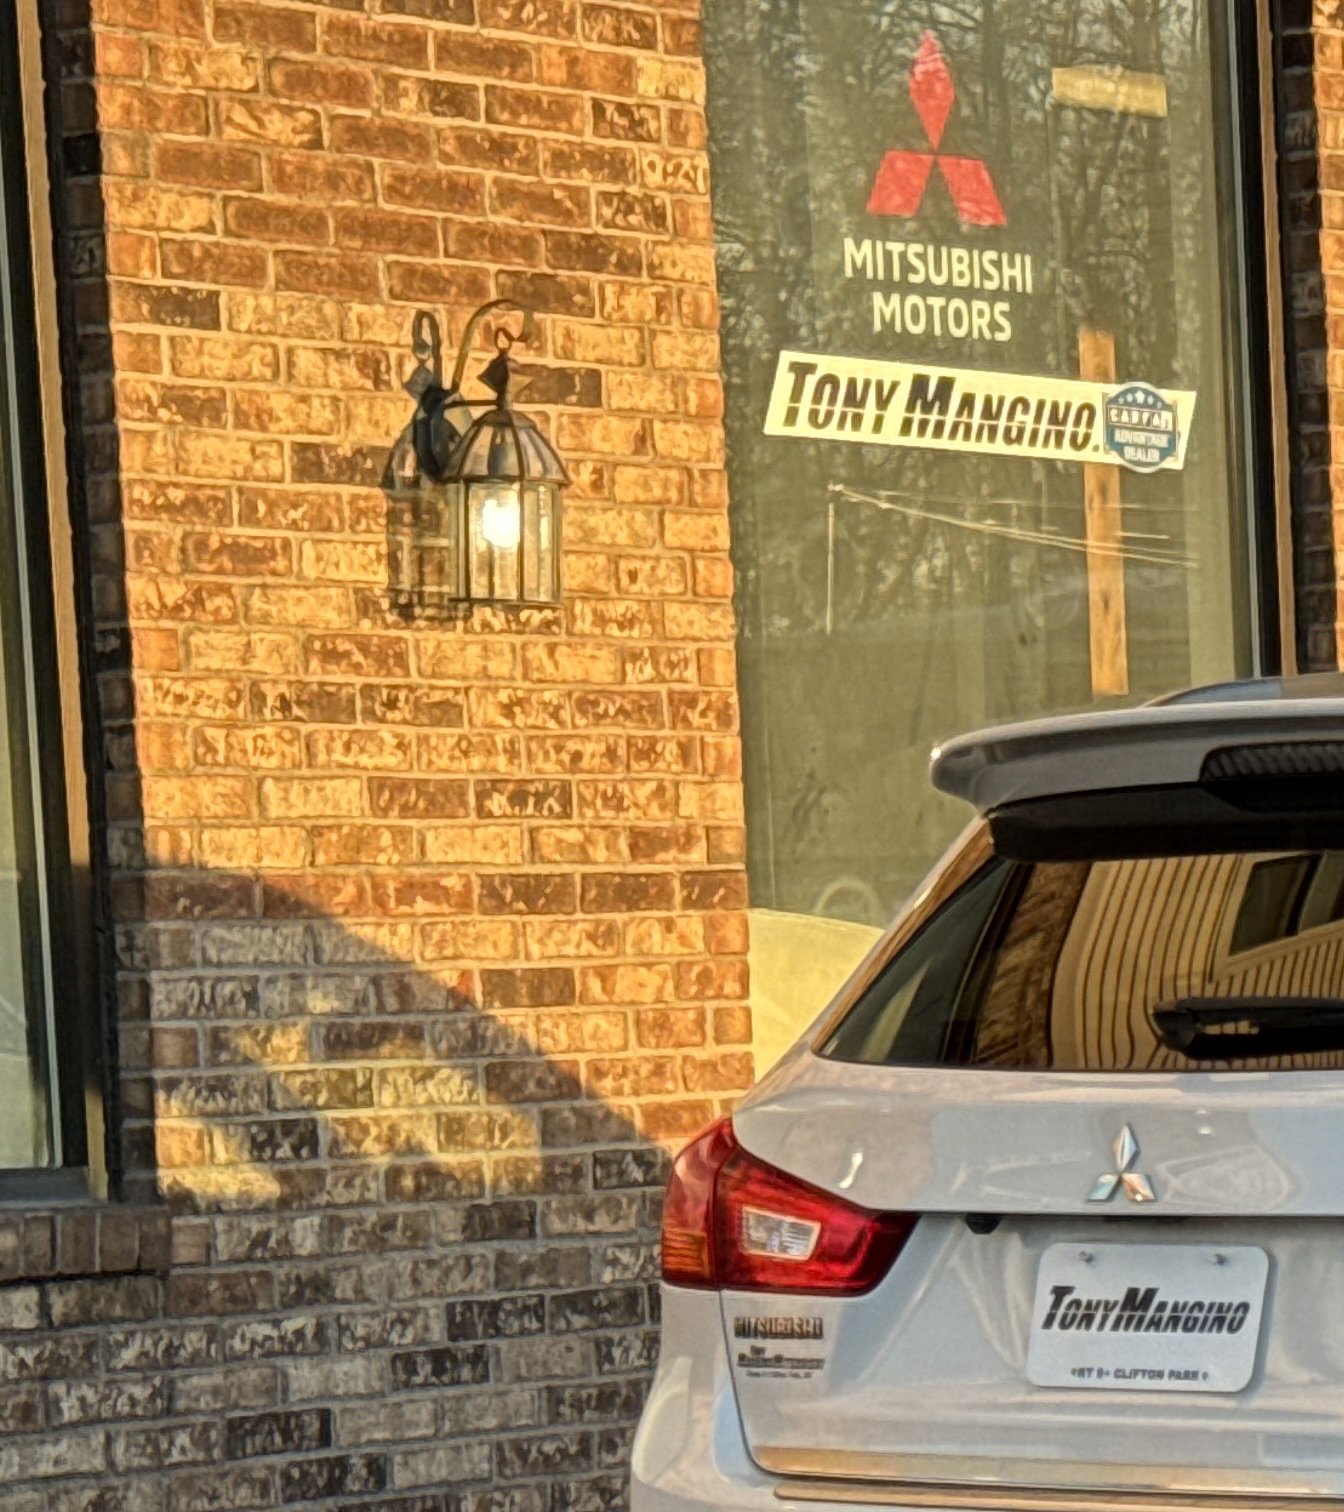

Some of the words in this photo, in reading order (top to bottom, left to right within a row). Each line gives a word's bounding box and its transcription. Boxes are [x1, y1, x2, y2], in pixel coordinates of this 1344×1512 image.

[844, 237, 1033, 294] MITSUBISHI
[872, 291, 1012, 342] MOTORS
[782, 361, 901, 436] TONY
[734, 1317, 824, 1339] MITSUBISHI
[1113, 1367, 1165, 1381] CLIFTON
[1167, 1369, 1200, 1382] PARK
